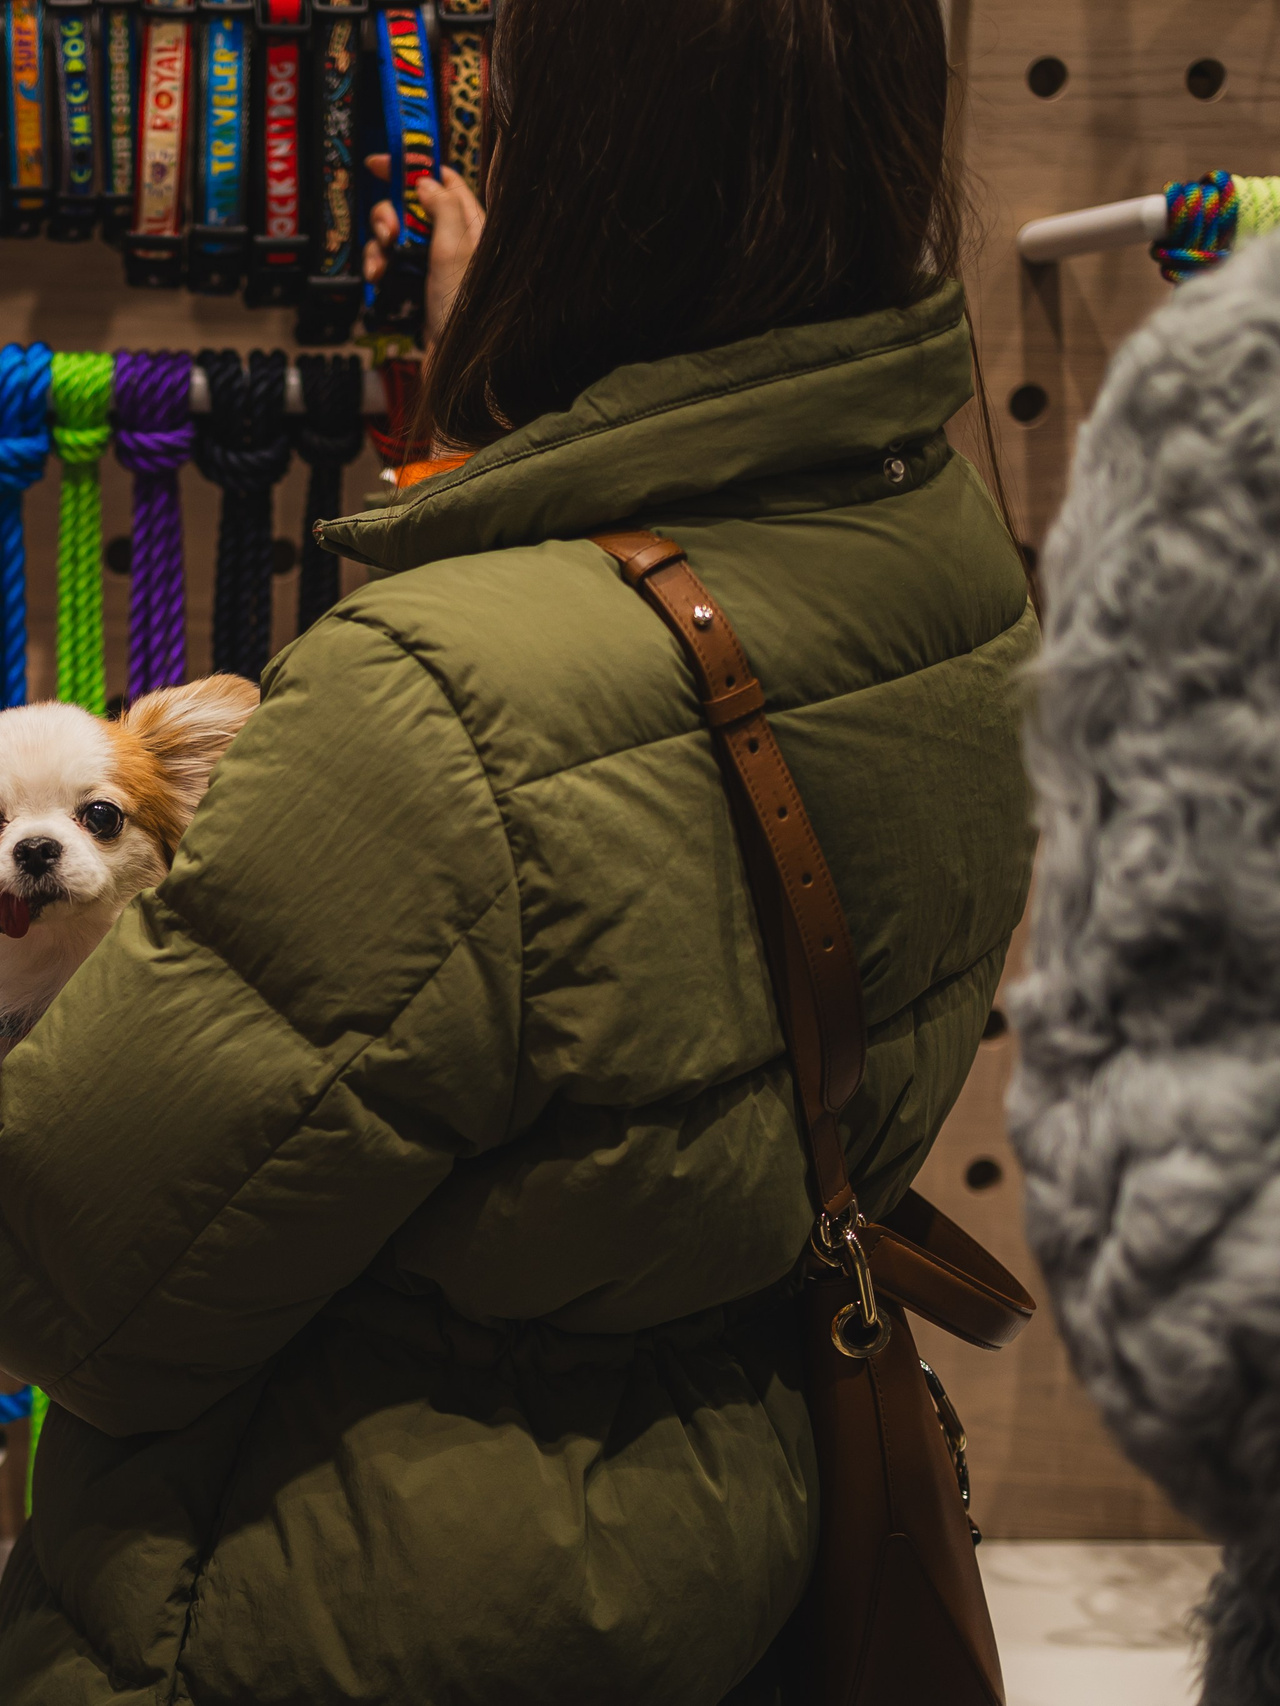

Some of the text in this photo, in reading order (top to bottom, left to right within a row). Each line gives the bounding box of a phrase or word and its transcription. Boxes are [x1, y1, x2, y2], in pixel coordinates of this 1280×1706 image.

[14, 26, 36, 72] SURF
[60, 20, 87, 73] DOG
[149, 38, 181, 132] ROYAL
[211, 48, 237, 176] TRAVELER
[267, 61, 296, 238] OCK'N'DOG
